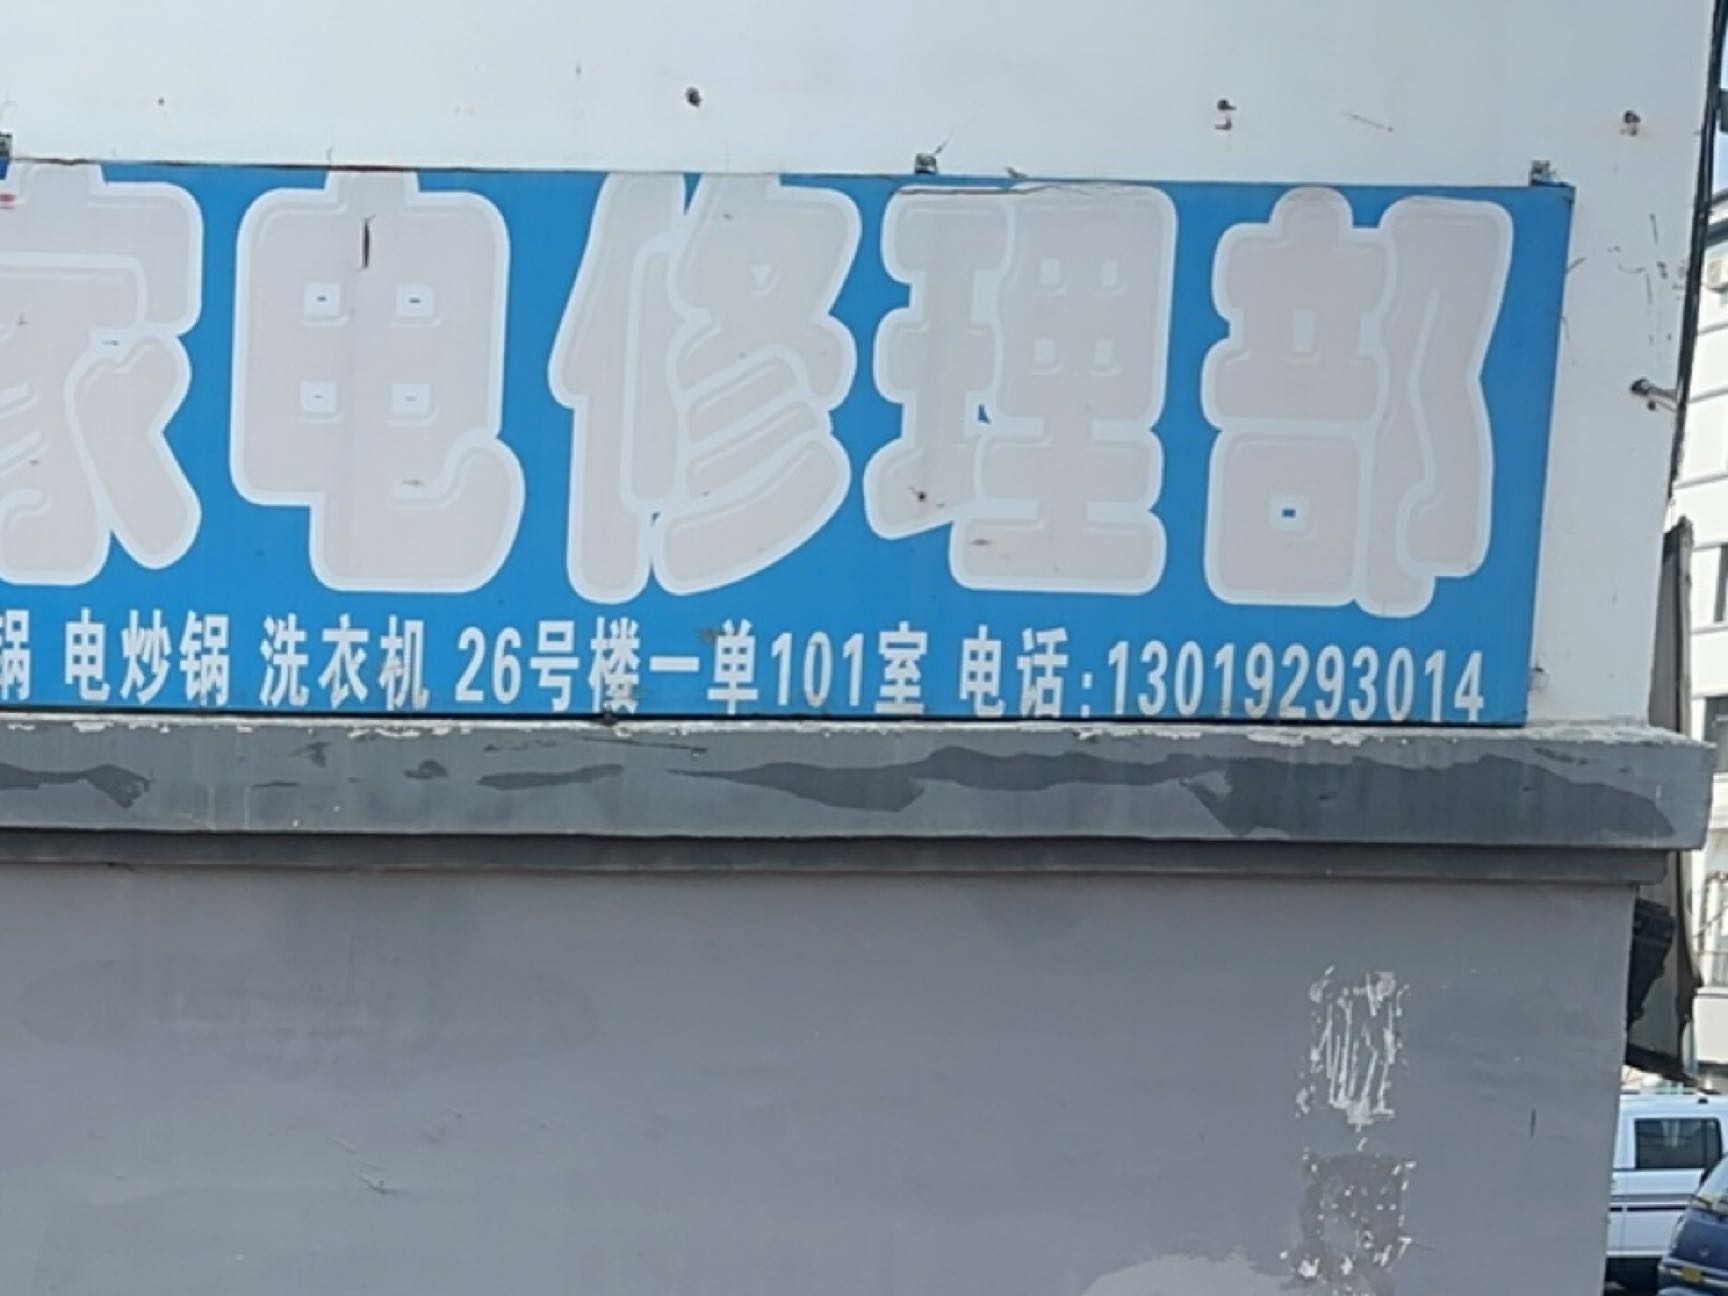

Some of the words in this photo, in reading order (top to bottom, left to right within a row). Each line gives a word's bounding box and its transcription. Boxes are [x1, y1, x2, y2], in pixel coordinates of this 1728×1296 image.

[64, 606, 232, 706] 电炒锅
[258, 612, 431, 711] 洗衣机
[454, 616, 929, 715] 26号楼一单101室
